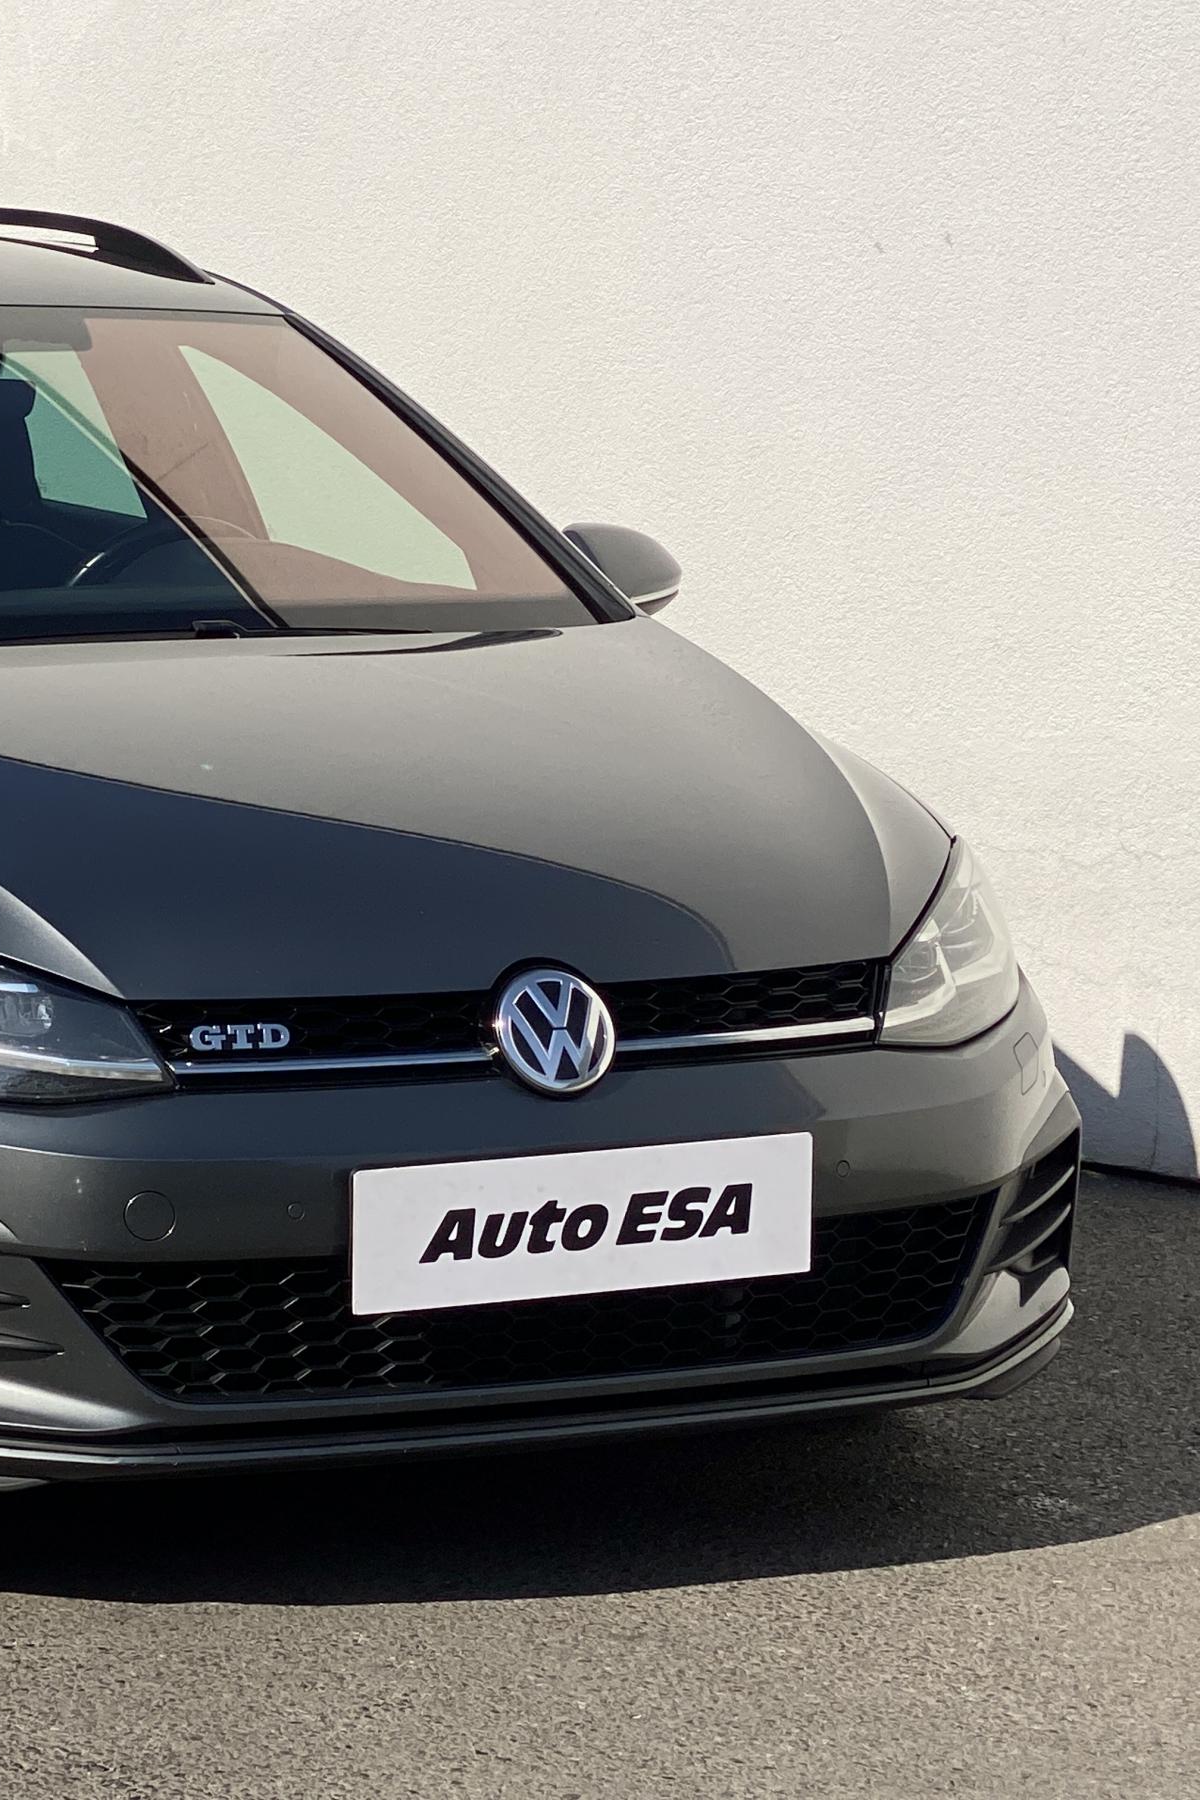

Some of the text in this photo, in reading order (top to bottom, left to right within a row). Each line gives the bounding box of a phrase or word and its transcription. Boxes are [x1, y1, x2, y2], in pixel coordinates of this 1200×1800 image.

[189, 1023, 291, 1051] GTD
[504, 975, 607, 1085] VW
[418, 1182, 753, 1264] Auto ESA
